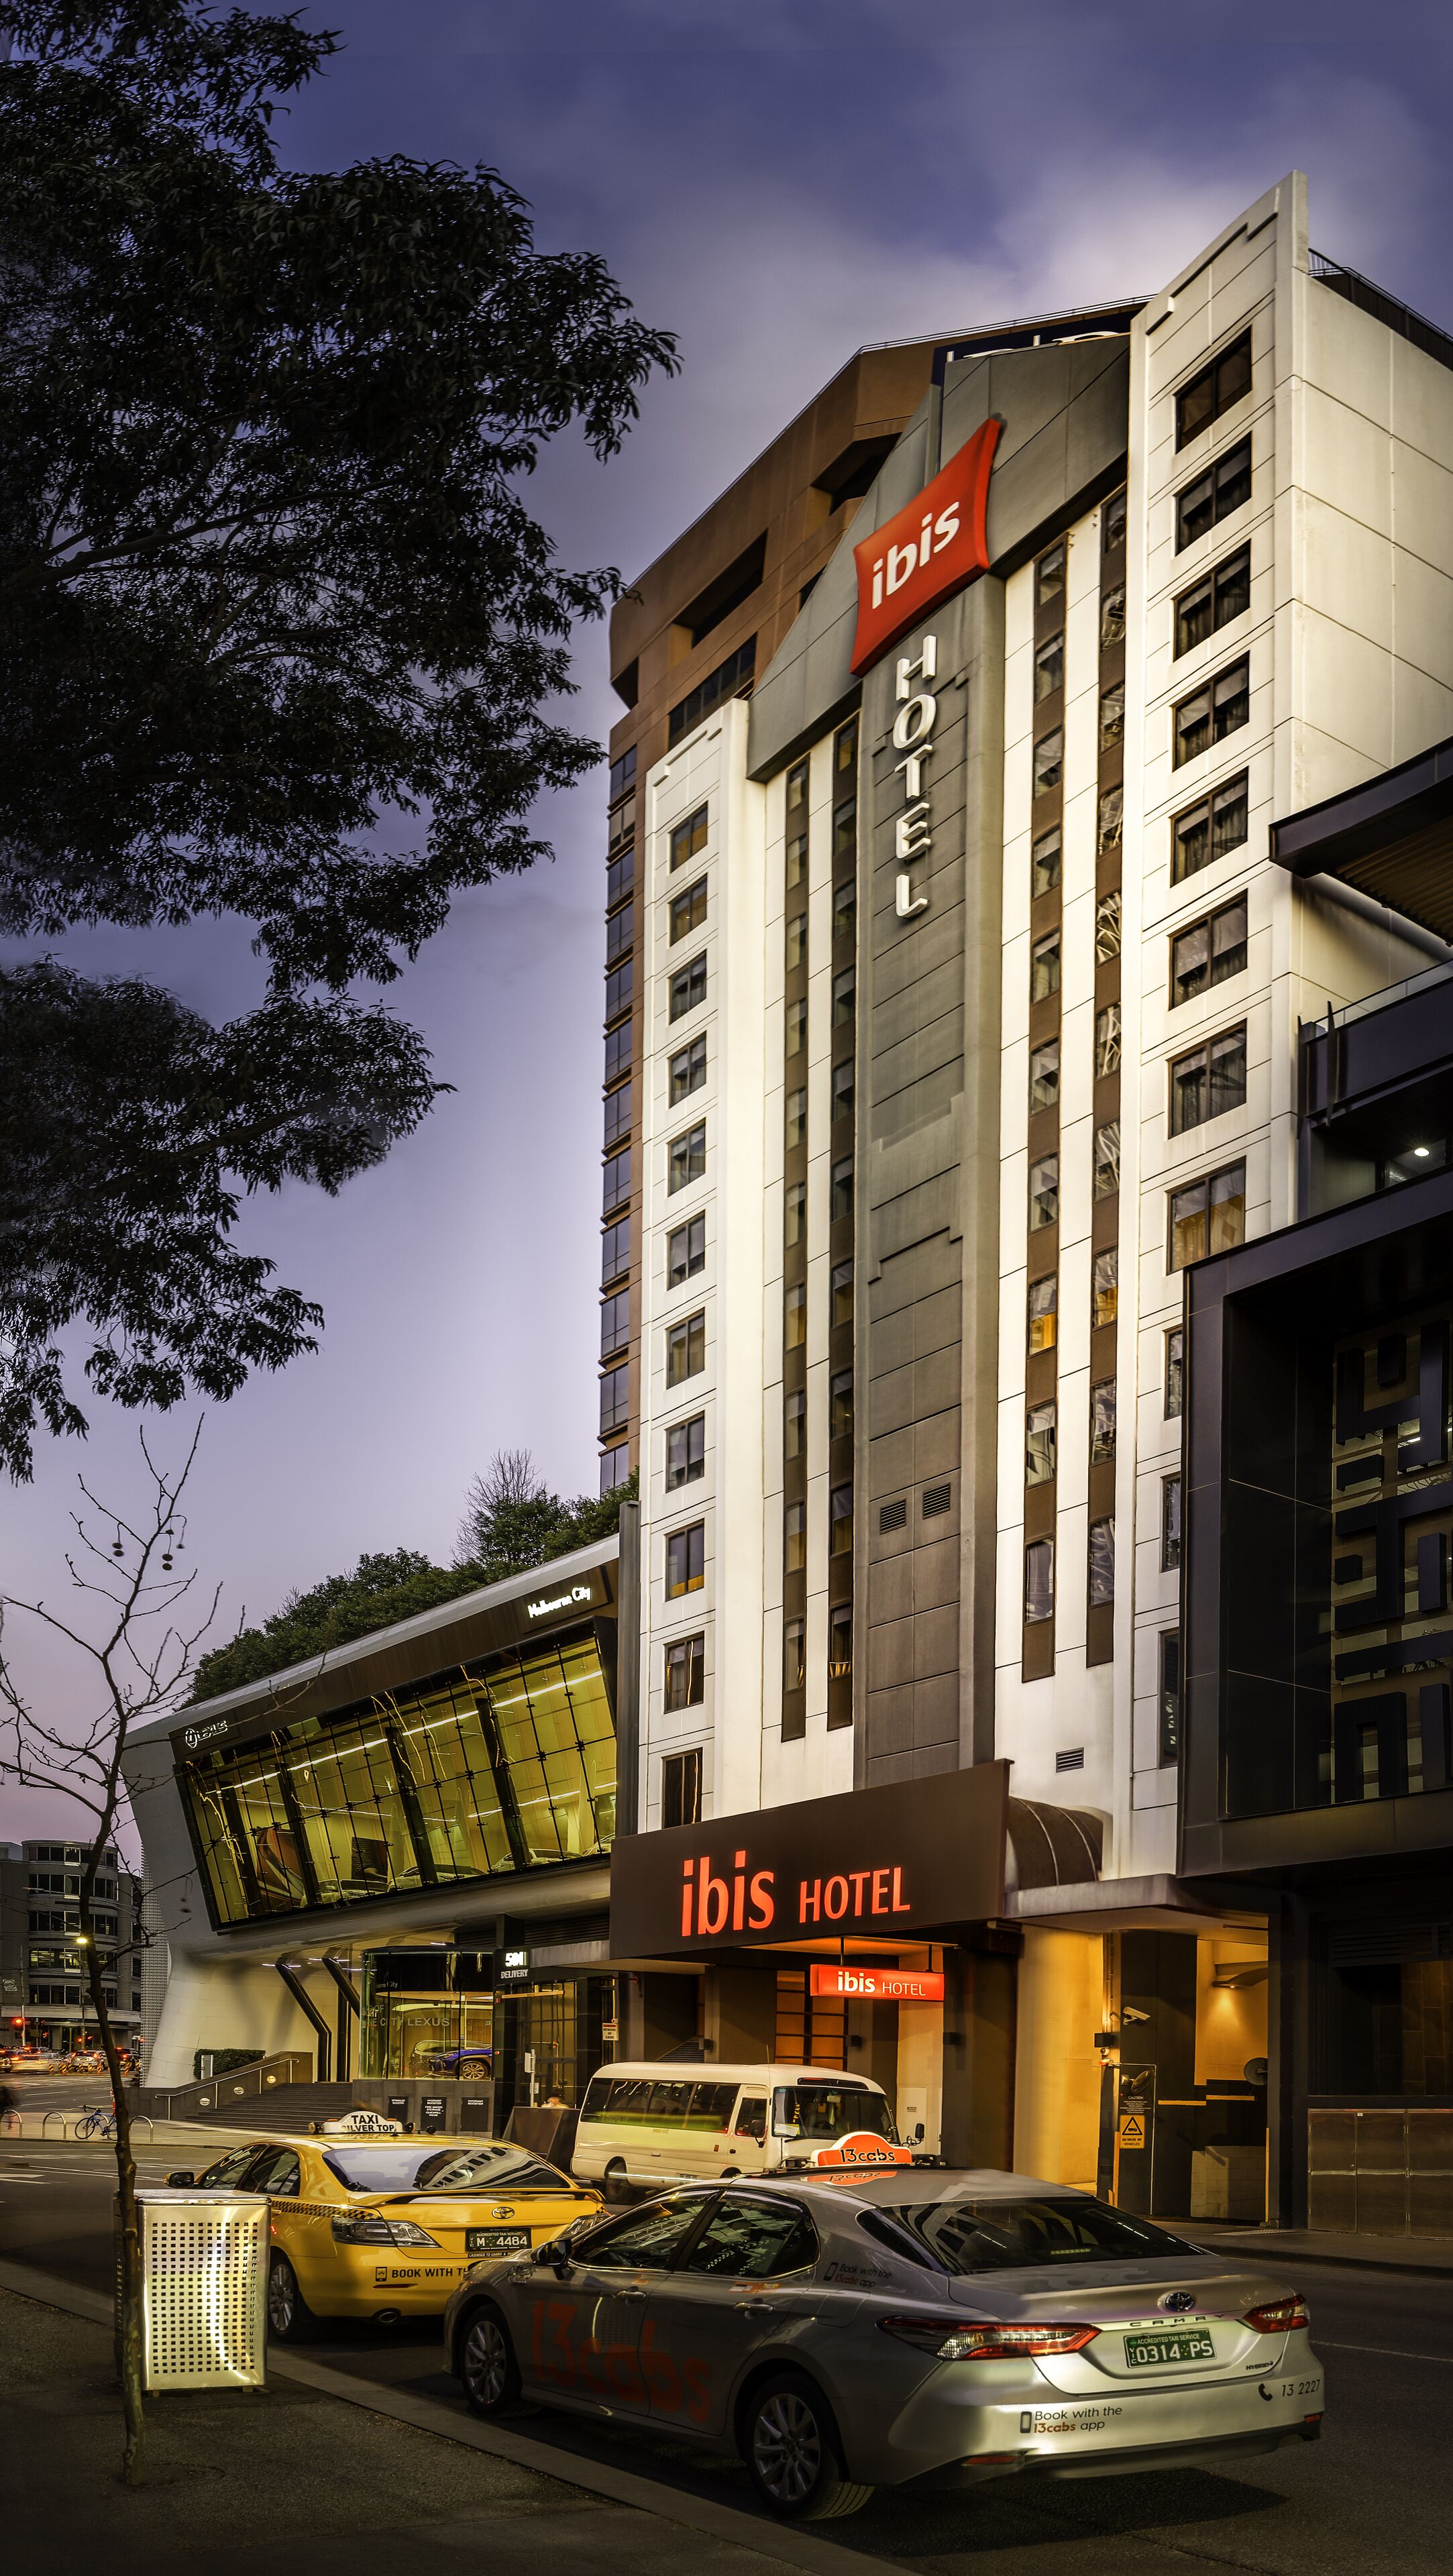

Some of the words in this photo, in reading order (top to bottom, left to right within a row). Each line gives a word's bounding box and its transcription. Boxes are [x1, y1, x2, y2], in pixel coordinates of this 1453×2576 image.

[871, 501, 961, 610] ibis
[892, 634, 937, 918] HOTEL
[681, 1850, 774, 1937] ibis
[799, 1867, 911, 1923] HOTEL
[500, 1969, 529, 1979] DELIVERY
[837, 1971, 875, 1992] ibis
[882, 1982, 926, 1996] HOTEL
[407, 2017, 450, 2027] LEXUS
[351, 2115, 379, 2125] TAXI
[840, 2148, 896, 2163] 13cabs
[476, 2237, 485, 2247] M
[496, 2236, 527, 2246] 4484
[392, 2268, 421, 2278] BOOK
[425, 2267, 453, 2277] WITH
[1179, 2333, 1200, 2341] SERVICE
[1129, 2348, 1138, 2364] VIC
[1136, 2343, 1181, 2363] 0314
[1189, 2341, 1213, 2357] PS
[1282, 2383, 1294, 2397] 13
[1298, 2379, 1321, 2395] 2227
[1034, 2410, 1068, 2421] Book
[1073, 2408, 1099, 2418] with
[1103, 2406, 1122, 2416] the
[1034, 2422, 1076, 2433] 13cabs
[1080, 2421, 1106, 2432] app
